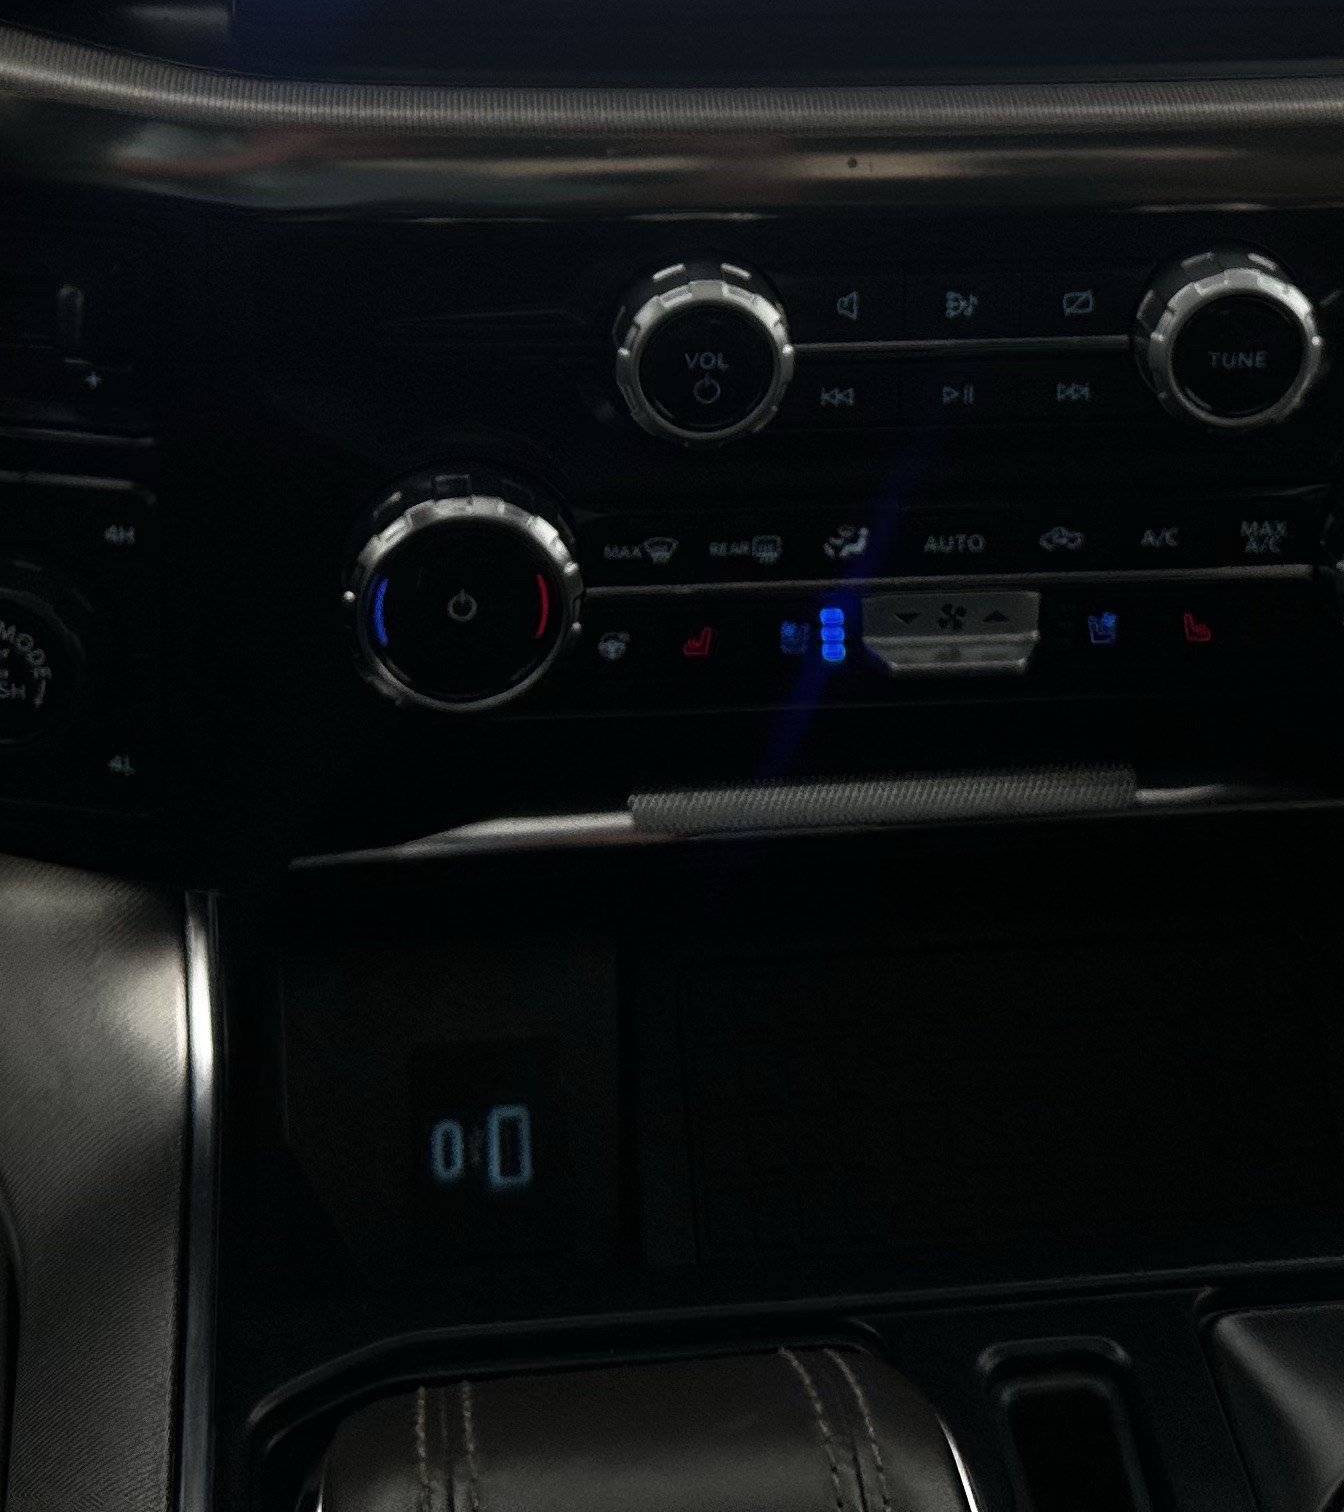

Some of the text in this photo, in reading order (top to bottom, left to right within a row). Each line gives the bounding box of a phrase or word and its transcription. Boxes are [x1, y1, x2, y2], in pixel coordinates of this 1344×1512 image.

[685, 351, 730, 371] VOL
[1208, 349, 1268, 370] TUNE
[104, 523, 136, 546] 4H
[1141, 526, 1181, 549] A/C
[1240, 520, 1288, 537] MAX
[604, 544, 642, 561] MAX
[923, 533, 987, 554] AUTO
[1244, 536, 1281, 554] A/C
